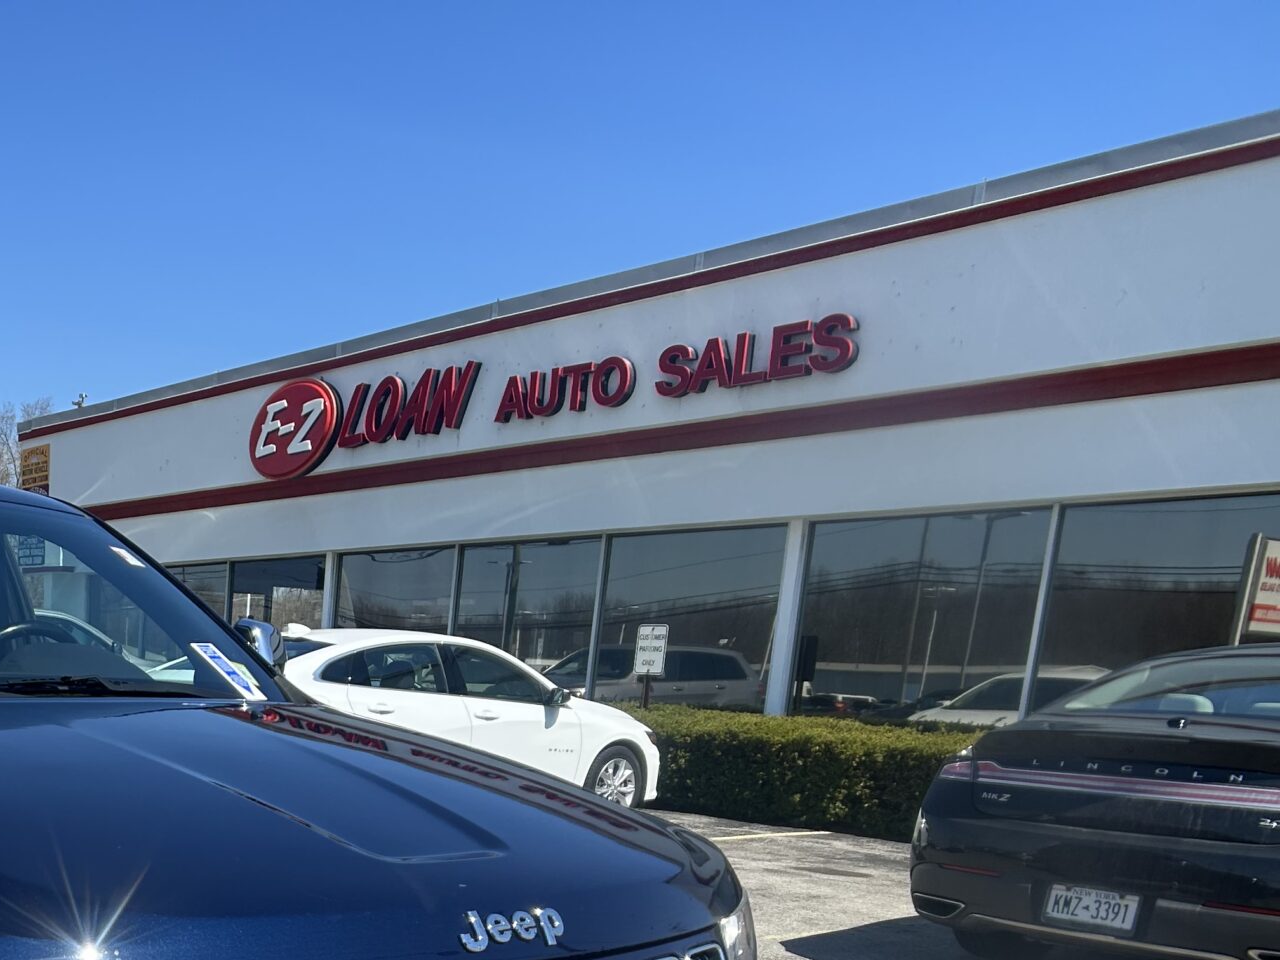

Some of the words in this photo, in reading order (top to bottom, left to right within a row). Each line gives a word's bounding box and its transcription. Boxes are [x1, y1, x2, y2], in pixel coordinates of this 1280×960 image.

[255, 397, 326, 459] E-Z
[338, 359, 482, 450] LOAN
[493, 355, 637, 425] AUTO
[654, 312, 860, 399] SALES
[1032, 759, 1244, 783] LINCOLN
[981, 790, 1012, 802] MKZ
[1072, 888, 1092, 897] NEW
[1095, 891, 1117, 900] YORK
[1051, 893, 1083, 917] KMZ
[1091, 899, 1129, 924] 3391
[460, 907, 565, 952] Jeep
